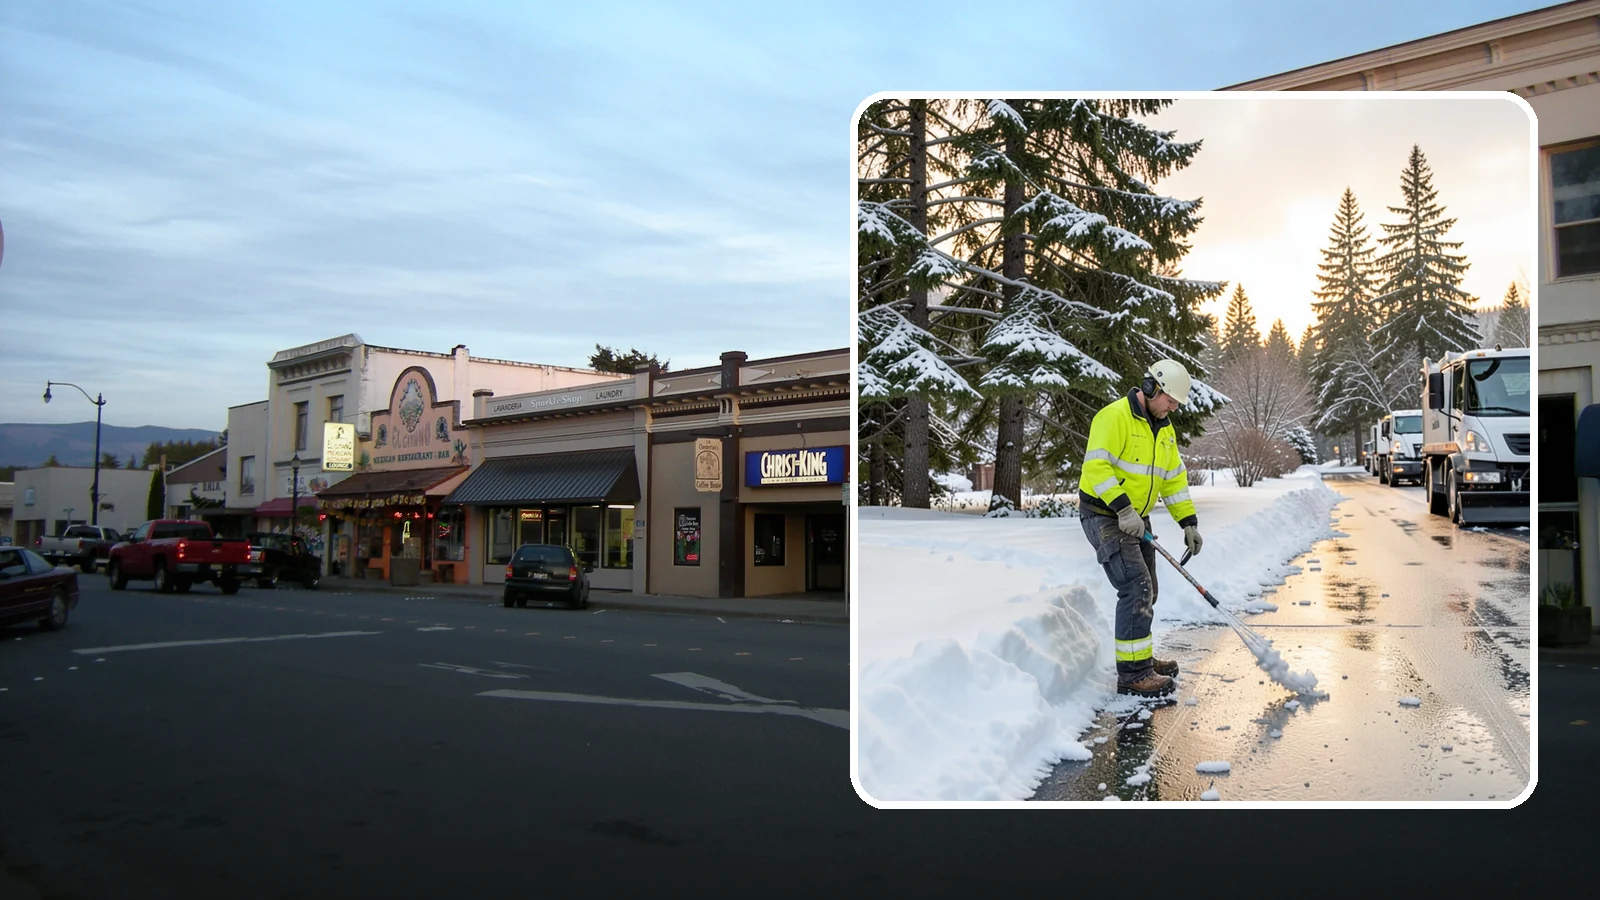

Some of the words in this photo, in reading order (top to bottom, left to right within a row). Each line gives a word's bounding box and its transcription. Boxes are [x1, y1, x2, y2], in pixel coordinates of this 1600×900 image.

[595, 389, 623, 399] LAUNDRY
[493, 402, 522, 412] LAVANDERIA
[531, 398, 560, 409] Sparkle
[562, 395, 582, 405] Shop
[373, 455, 397, 464] MEXICAN
[398, 452, 433, 462] RESTAURANT
[437, 450, 450, 459] BAR
